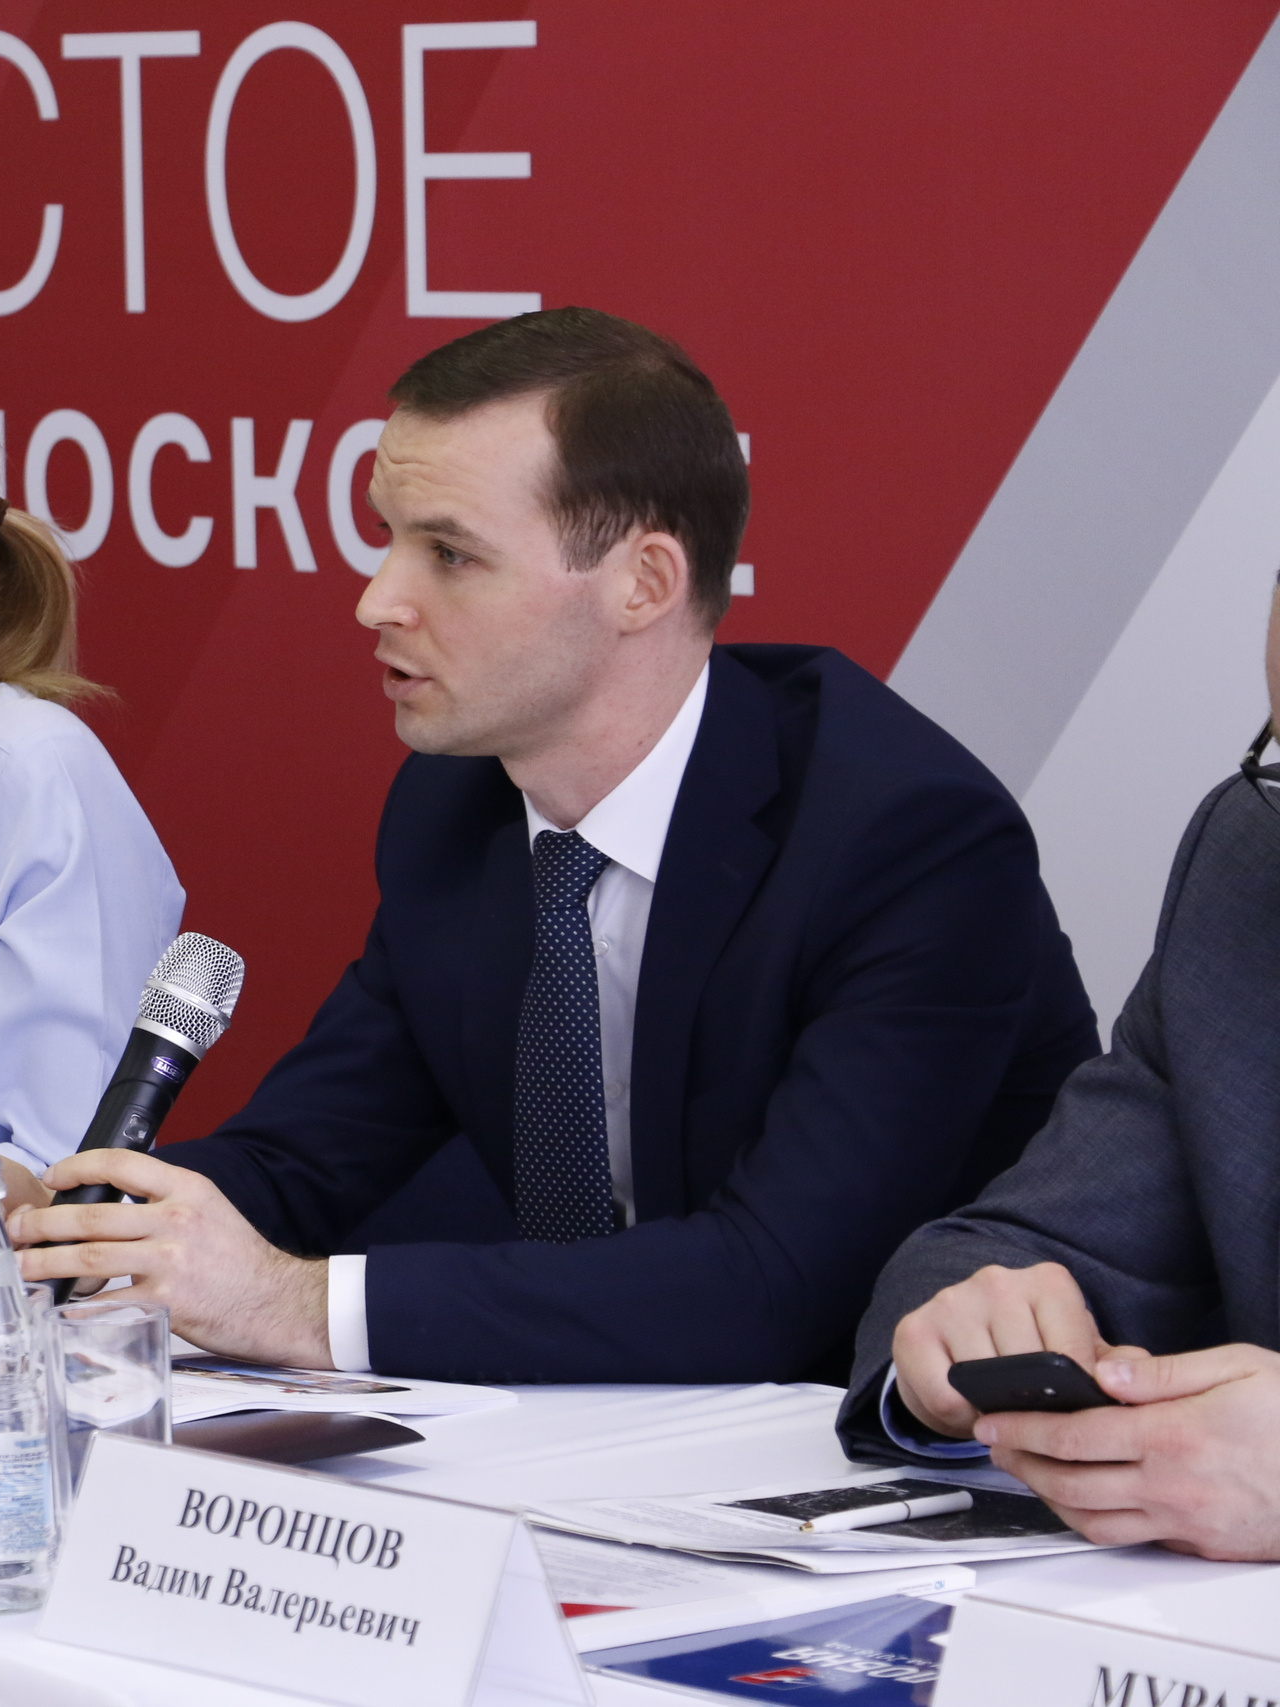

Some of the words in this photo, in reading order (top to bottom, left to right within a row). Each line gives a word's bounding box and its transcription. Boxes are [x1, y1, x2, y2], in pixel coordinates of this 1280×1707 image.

[176, 1488, 406, 1571] ВОРОНЦОВ
[109, 1544, 214, 1601] Вадим
[218, 1567, 422, 1647] Валерьевич
